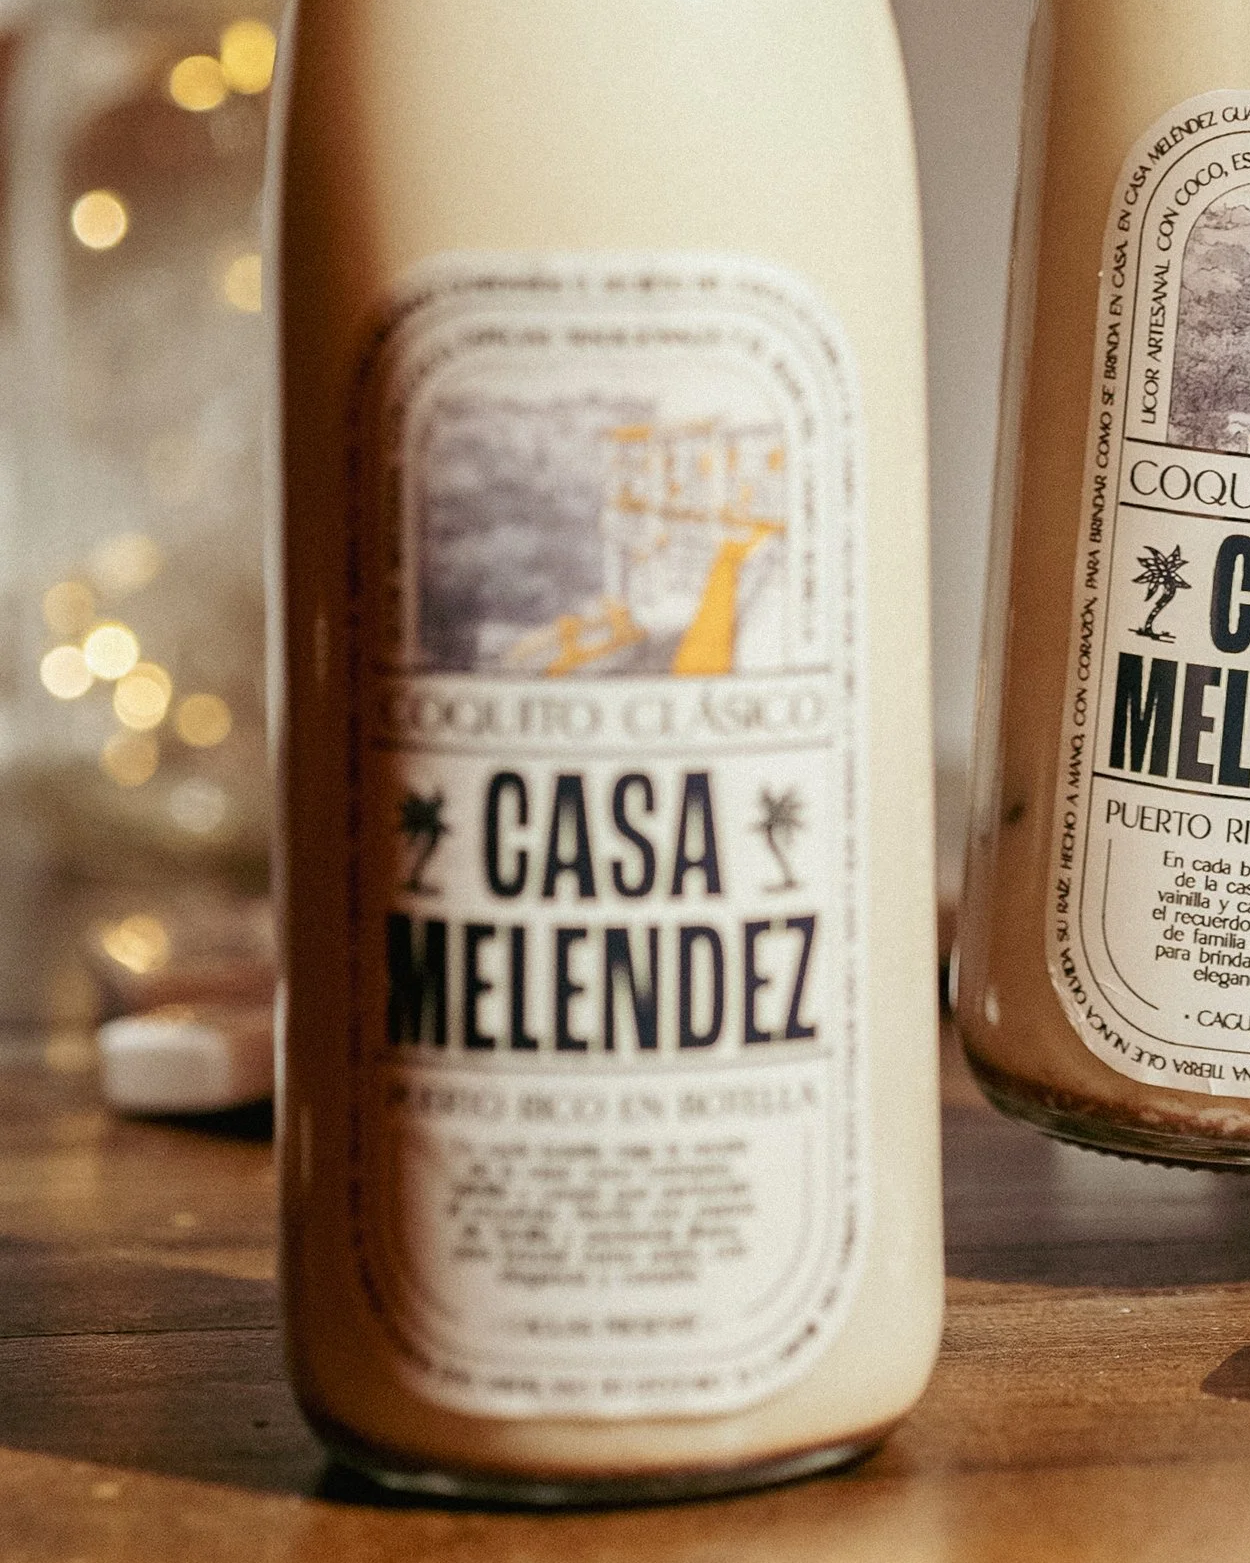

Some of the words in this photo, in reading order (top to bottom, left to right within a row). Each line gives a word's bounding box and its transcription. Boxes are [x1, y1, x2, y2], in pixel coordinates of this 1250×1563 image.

[1124, 165, 1152, 205] CASA
[1174, 161, 1229, 207] COCO,
[1117, 209, 1132, 232] EN
[1157, 206, 1180, 252] CON
[1109, 293, 1123, 317] EN
[1147, 258, 1171, 363] ARTESANAL
[1104, 322, 1121, 380] BRINDA
[1101, 384, 1117, 407] SE
[1141, 367, 1160, 425] LICOR
[1095, 411, 1113, 469] COMO
[1089, 474, 1107, 544] BRINDAR
[1085, 549, 1100, 590] PARA
[1072, 688, 1087, 728] CON
[1066, 793, 1079, 807] A
[1105, 798, 1212, 840] PUERTO
[484, 770, 724, 899] CASA
[1059, 811, 1077, 870] HECHO
[1162, 850, 1185, 869] En
[1191, 857, 1232, 876] cada
[1174, 872, 1196, 889] de
[1204, 875, 1218, 892] la
[1152, 905, 1167, 922] el
[1157, 890, 1211, 909] vainilla
[1218, 898, 1230, 915] y
[1155, 944, 1191, 961] para
[1162, 924, 1186, 942] de
[1193, 927, 1246, 951] familia
[386, 913, 817, 1052] MELENDEZ
[1086, 1005, 1130, 1055] NUNCA
[1130, 1047, 1167, 1071] QUE
[1172, 1058, 1225, 1080] TIERRA
